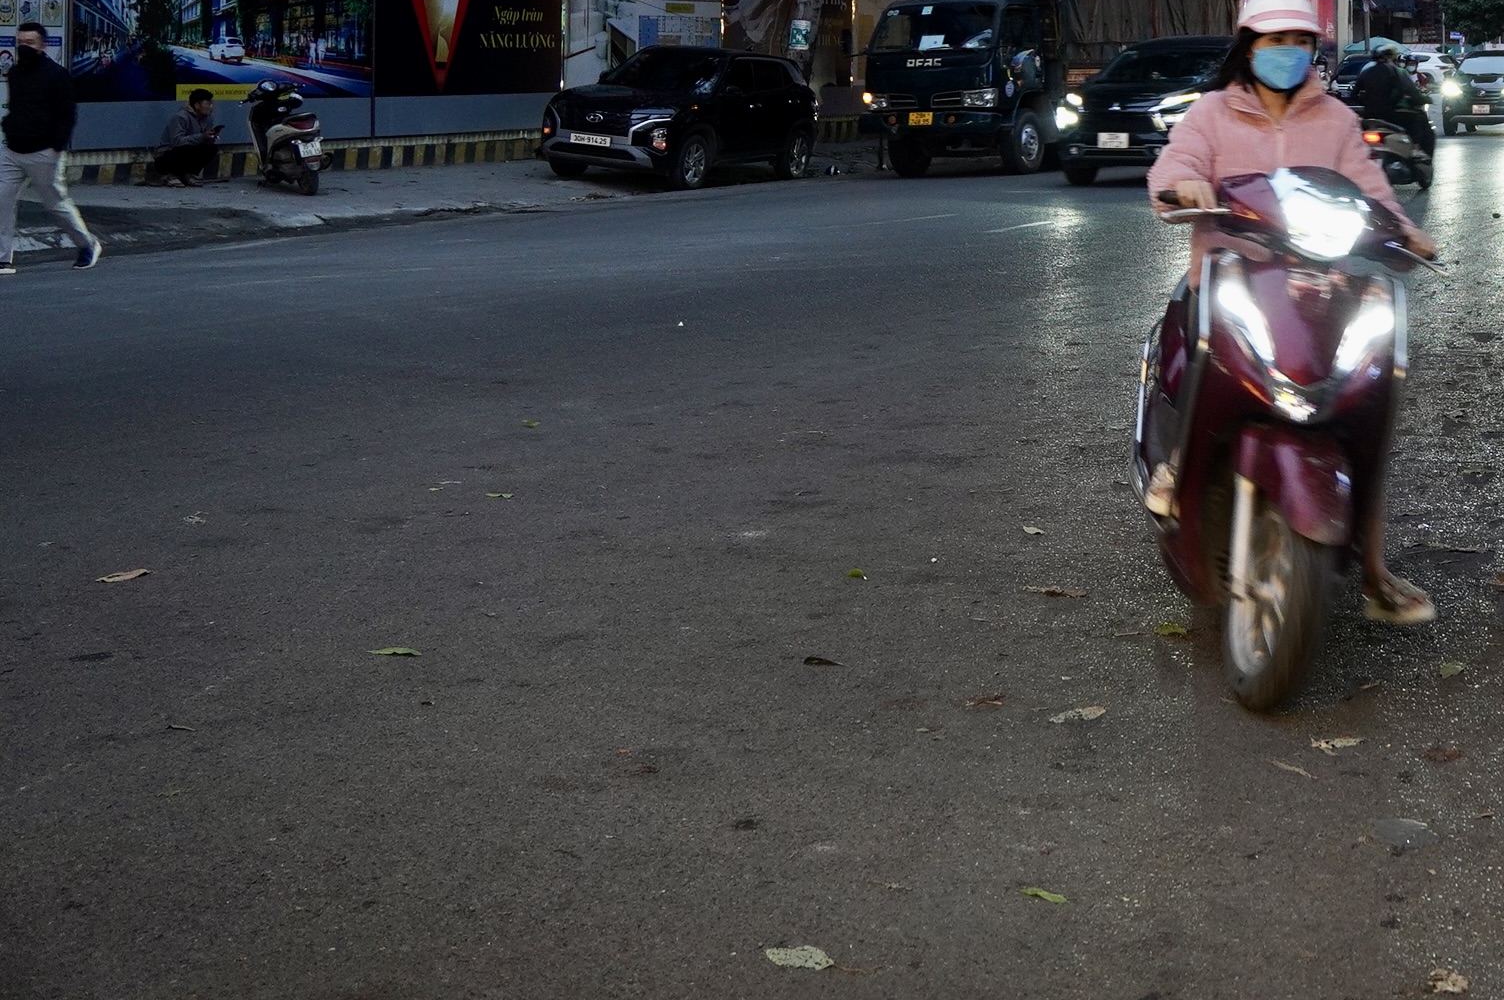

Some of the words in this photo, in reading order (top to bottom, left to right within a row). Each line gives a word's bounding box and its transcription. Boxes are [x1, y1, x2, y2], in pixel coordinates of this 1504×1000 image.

[492, 5, 520, 25] Ngập
[522, 7, 544, 22] tràn
[479, 31, 512, 49] NĂNG
[515, 31, 555, 53] LƯỢNG
